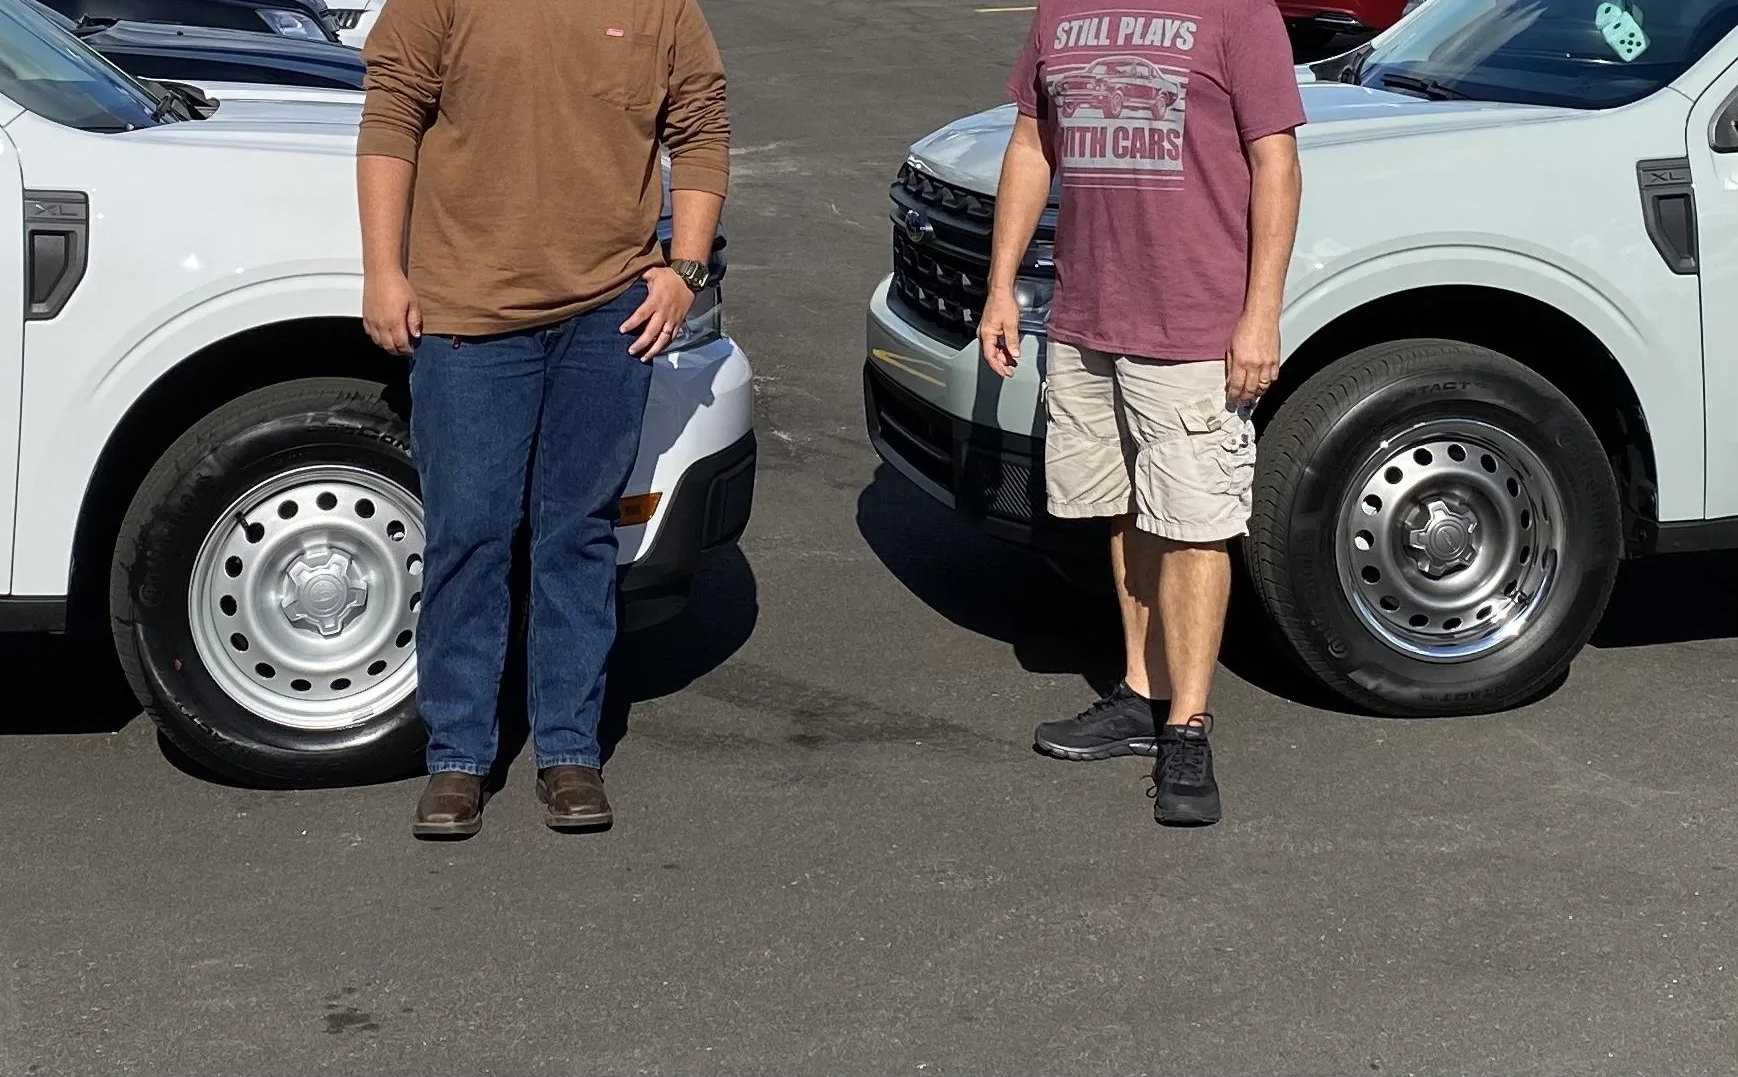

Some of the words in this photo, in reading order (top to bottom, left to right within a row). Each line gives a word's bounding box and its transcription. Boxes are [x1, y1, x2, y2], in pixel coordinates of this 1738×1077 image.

[1054, 17, 1110, 50] STILL
[1116, 17, 1197, 51] PLAYS
[1112, 125, 1181, 161] CARS
[1649, 171, 1686, 183] XL
[35, 203, 78, 217] XL
